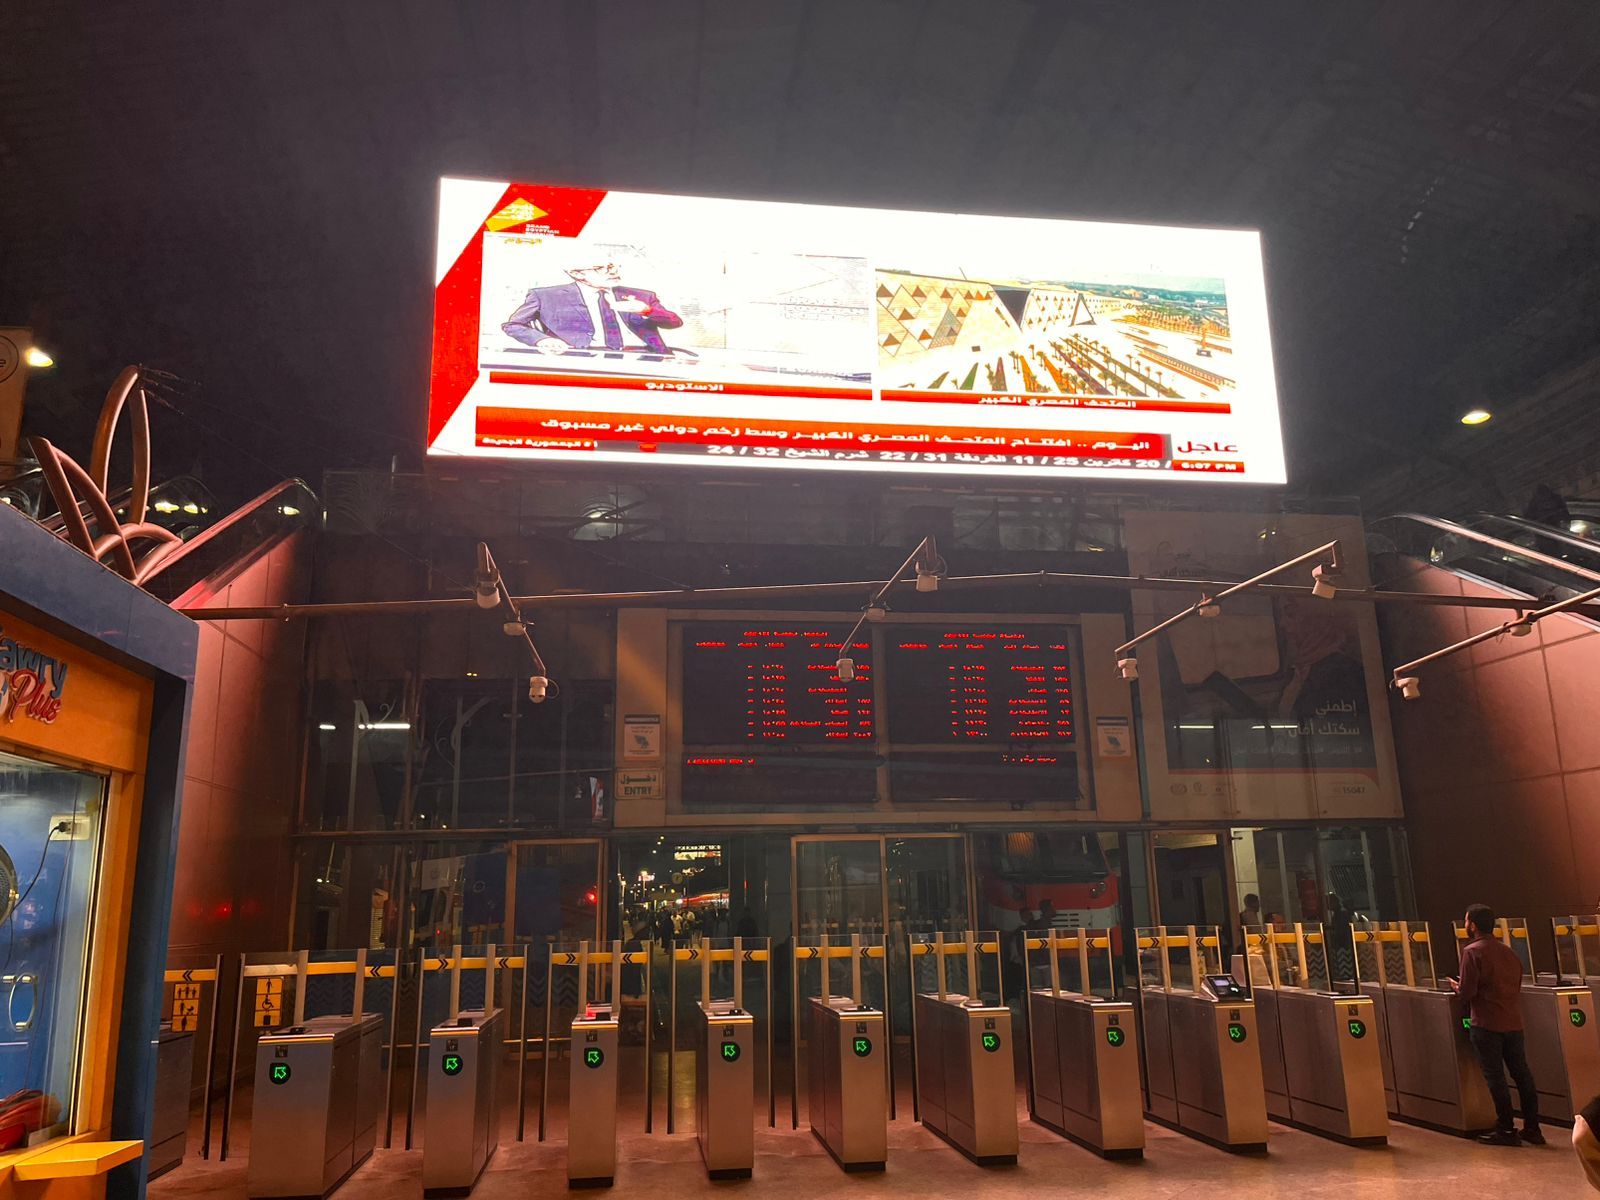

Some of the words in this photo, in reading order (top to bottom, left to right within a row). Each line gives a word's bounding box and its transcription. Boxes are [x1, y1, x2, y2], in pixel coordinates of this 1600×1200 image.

[645, 382, 724, 392] الاستوديو
[978, 396, 1021, 405] الكبير
[1026, 398, 1079, 407] المصري
[1084, 399, 1137, 408] المتحف
[540, 418, 611, 431] مسبوق
[614, 421, 645, 433] غير
[649, 423, 699, 435] دولي
[703, 425, 740, 437] زخم
[744, 426, 789, 439] وسط
[792, 431, 853, 441] الكبير
[858, 432, 930, 443] المصري
[934, 436, 1005, 446] المتحف
[1011, 438, 1071, 448] افتتاح
[1092, 441, 1150, 451] اليوم
[1177, 440, 1239, 454] عاجل
[707, 445, 735, 455] 24
[753, 446, 780, 456] 32
[785, 447, 830, 458] الشيخ
[834, 450, 870, 460] شرم
[880, 451, 906, 460] 22
[923, 452, 947, 462] 31
[954, 452, 1007, 464] الغردقة
[1012, 455, 1035, 465] 11
[1053, 456, 1079, 466] 25
[1135, 459, 1161, 469] 20
[1181, 461, 1211, 470] 6:07
[1215, 463, 1237, 471] PM
[0, 637, 68, 699] awry
[9, 669, 62, 723] Plus
[1318, 721, 1360, 736] سكتك
[620, 773, 657, 785] دخول
[624, 786, 652, 795] ENTRY
